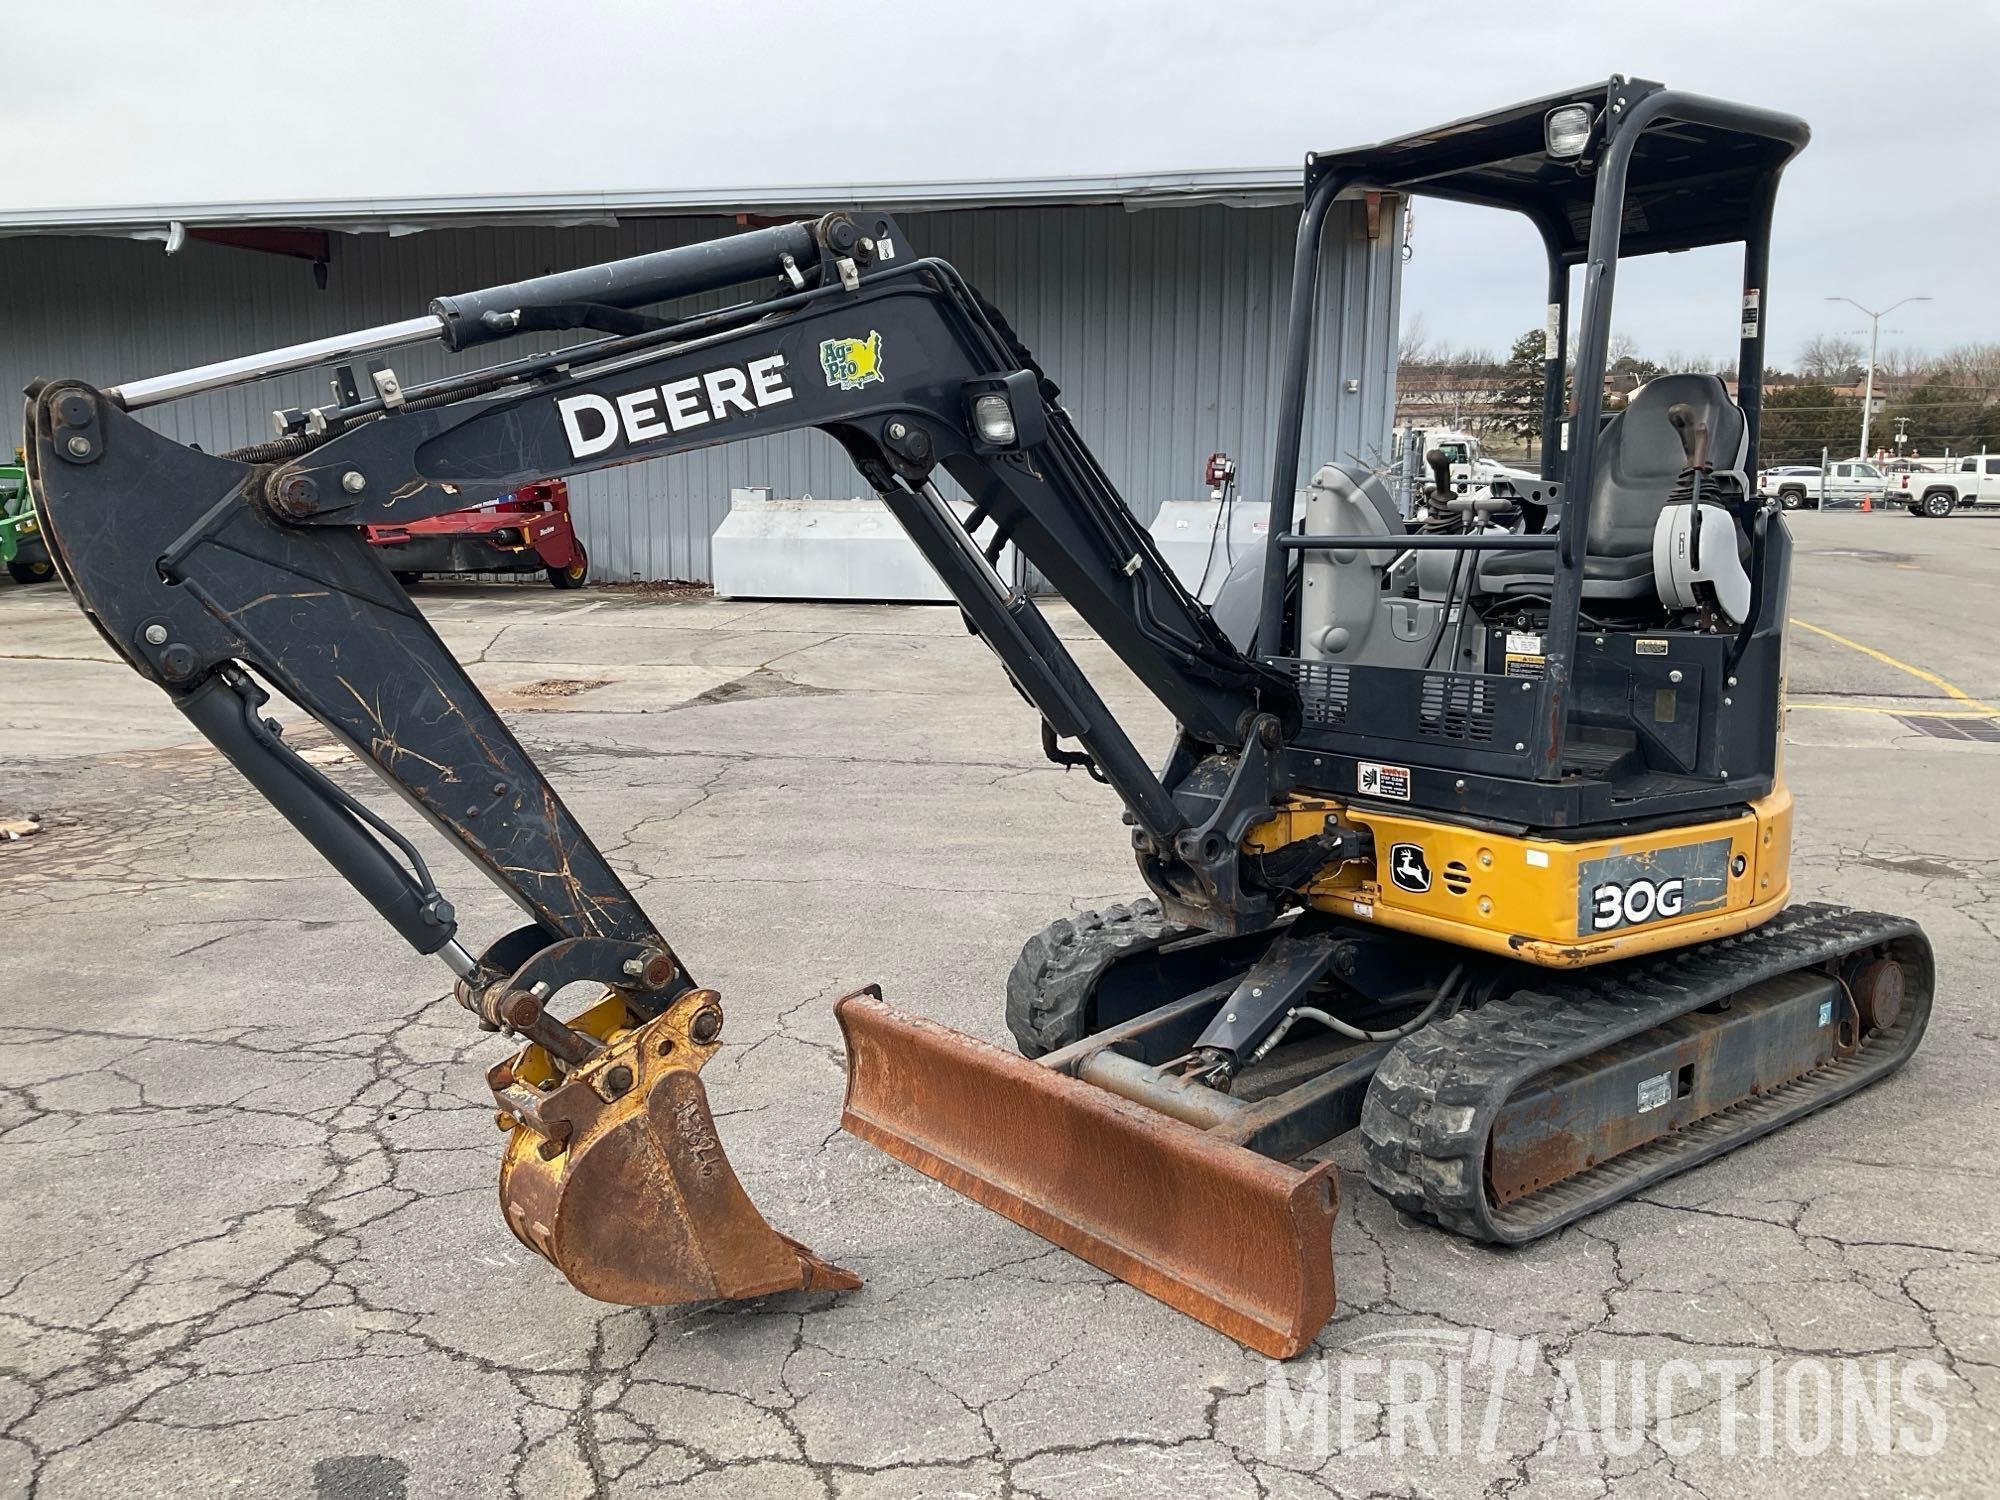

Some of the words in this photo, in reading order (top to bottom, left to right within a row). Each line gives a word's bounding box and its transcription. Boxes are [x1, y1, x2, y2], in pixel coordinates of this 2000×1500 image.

[824, 342, 852, 364] Ag-
[827, 361, 857, 382] Pro
[558, 354, 793, 458] DEERE
[1593, 878, 1684, 930] 30G
